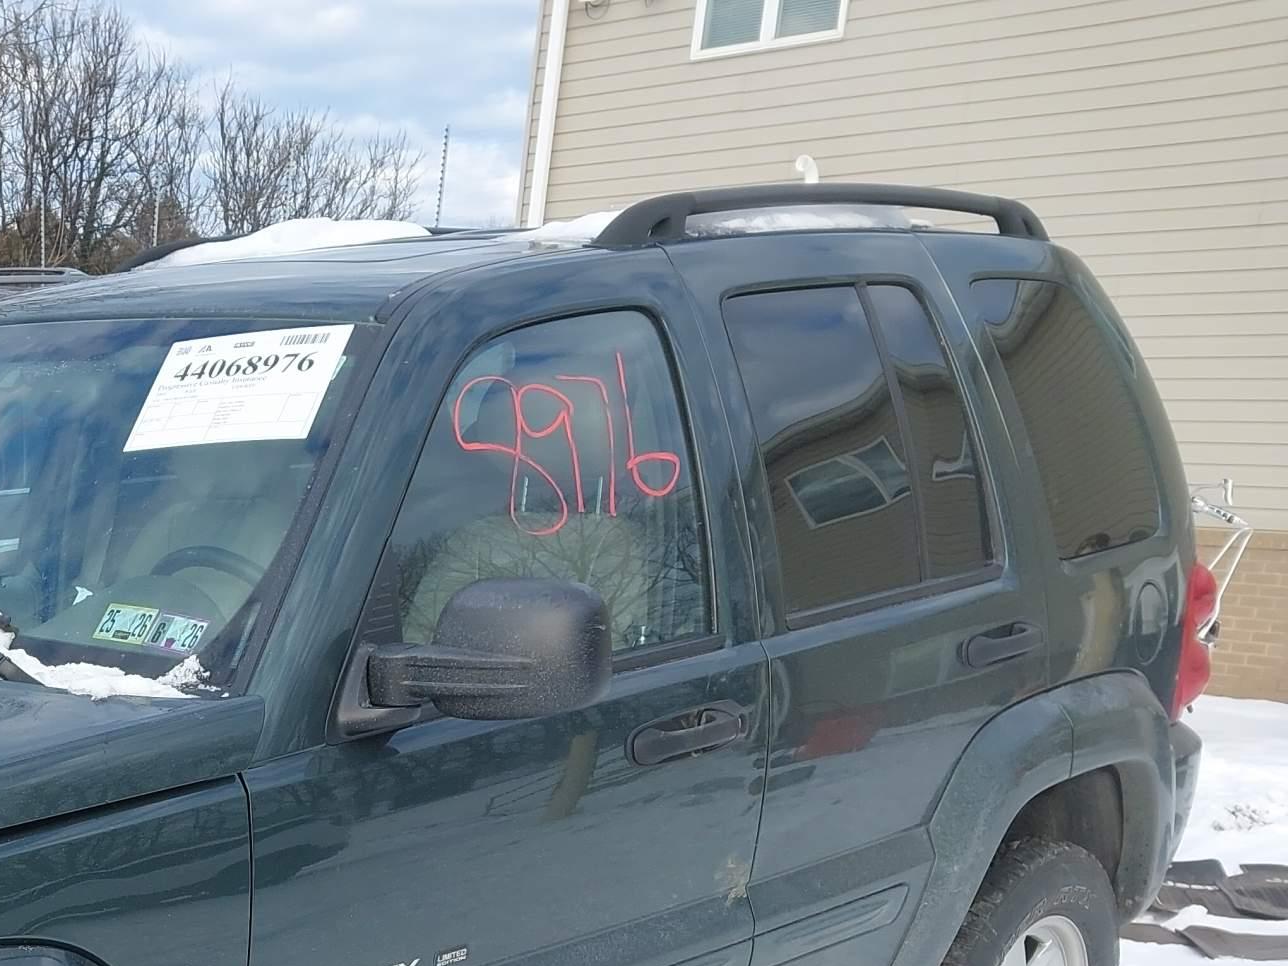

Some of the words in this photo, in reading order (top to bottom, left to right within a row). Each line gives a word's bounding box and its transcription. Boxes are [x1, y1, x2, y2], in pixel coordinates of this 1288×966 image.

[173, 350, 319, 382] 44068976
[452, 351, 681, 536] 8976
[98, 609, 121, 633] 25
[131, 613, 153, 638] 26
[181, 623, 205, 649] 26
[436, 947, 468, 963] LIMITED
